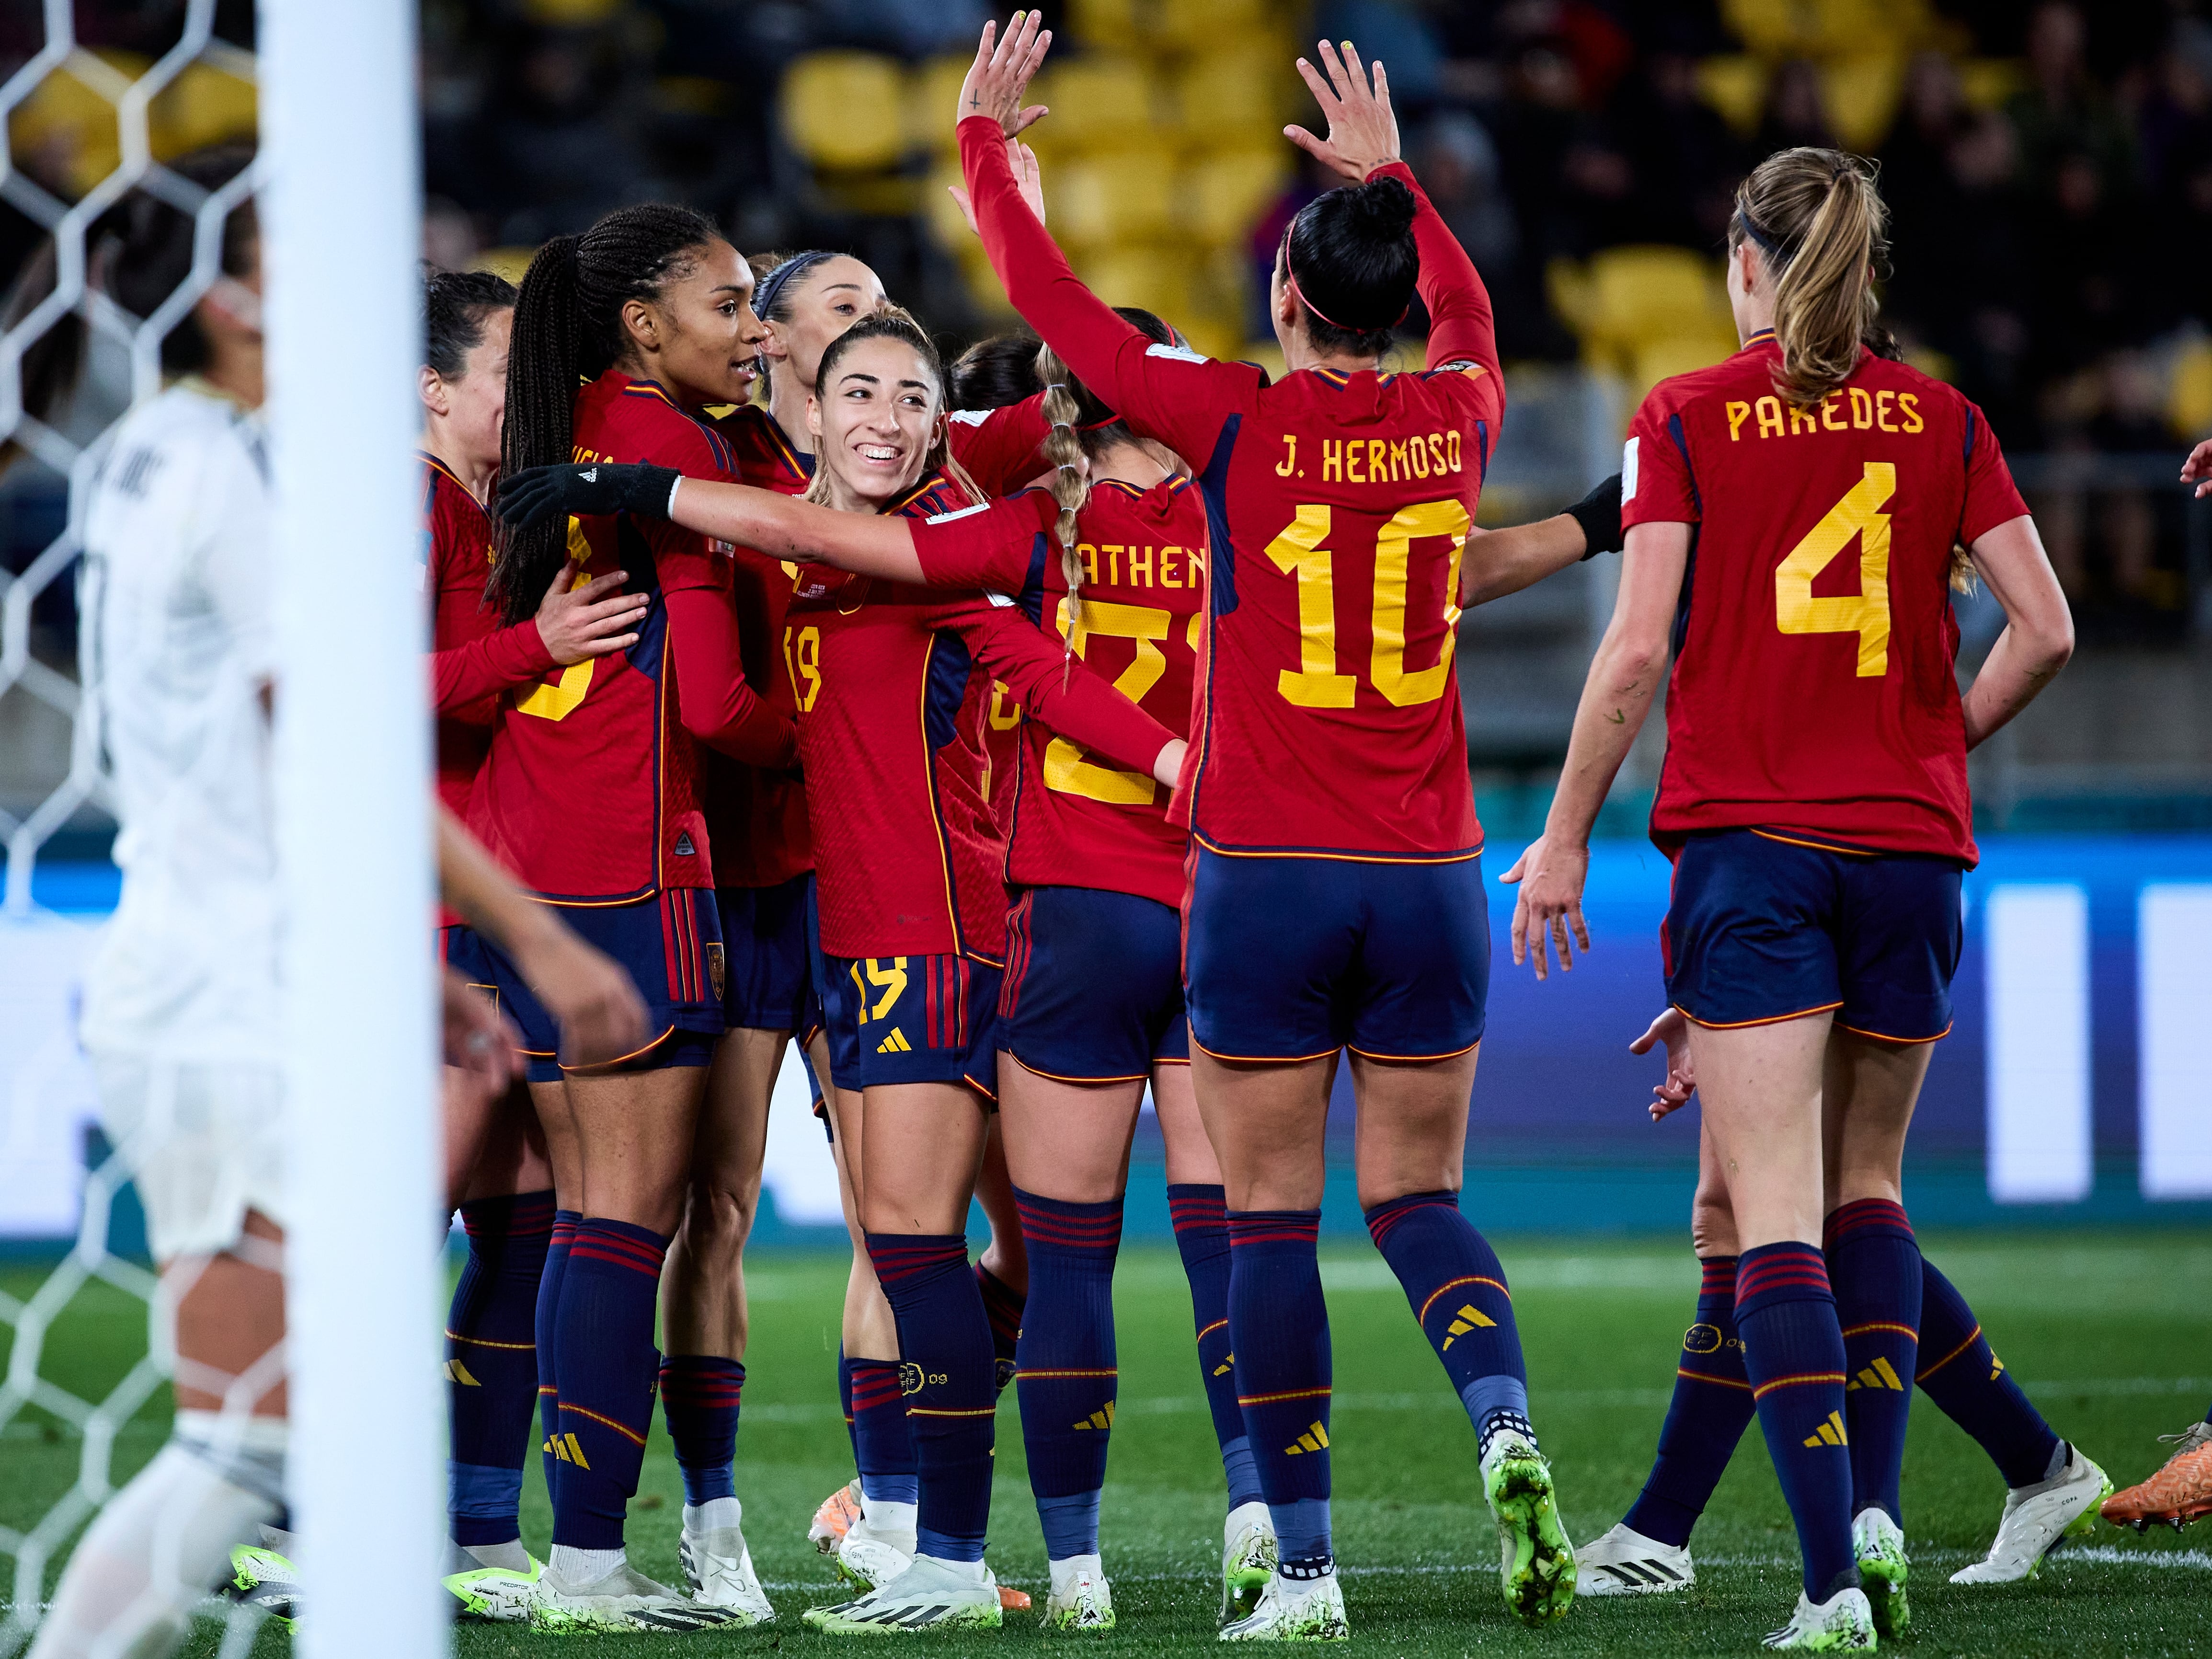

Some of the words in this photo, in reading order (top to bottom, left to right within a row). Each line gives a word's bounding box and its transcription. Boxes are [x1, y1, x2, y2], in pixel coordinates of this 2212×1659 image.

[1726, 387, 1924, 441] PAREDES
[1275, 434, 1305, 478] J.
[1323, 430, 1462, 483] HERMOSO
[1075, 543, 1206, 588] ATHEN
[1775, 461, 1896, 678] 4
[1263, 499, 1470, 708] 10
[782, 626, 822, 713] 19
[1043, 597, 1205, 806] 2
[849, 956, 907, 1025] 19
[928, 1373, 948, 1385] 09
[499, 1581, 529, 1590] PREDATOR
